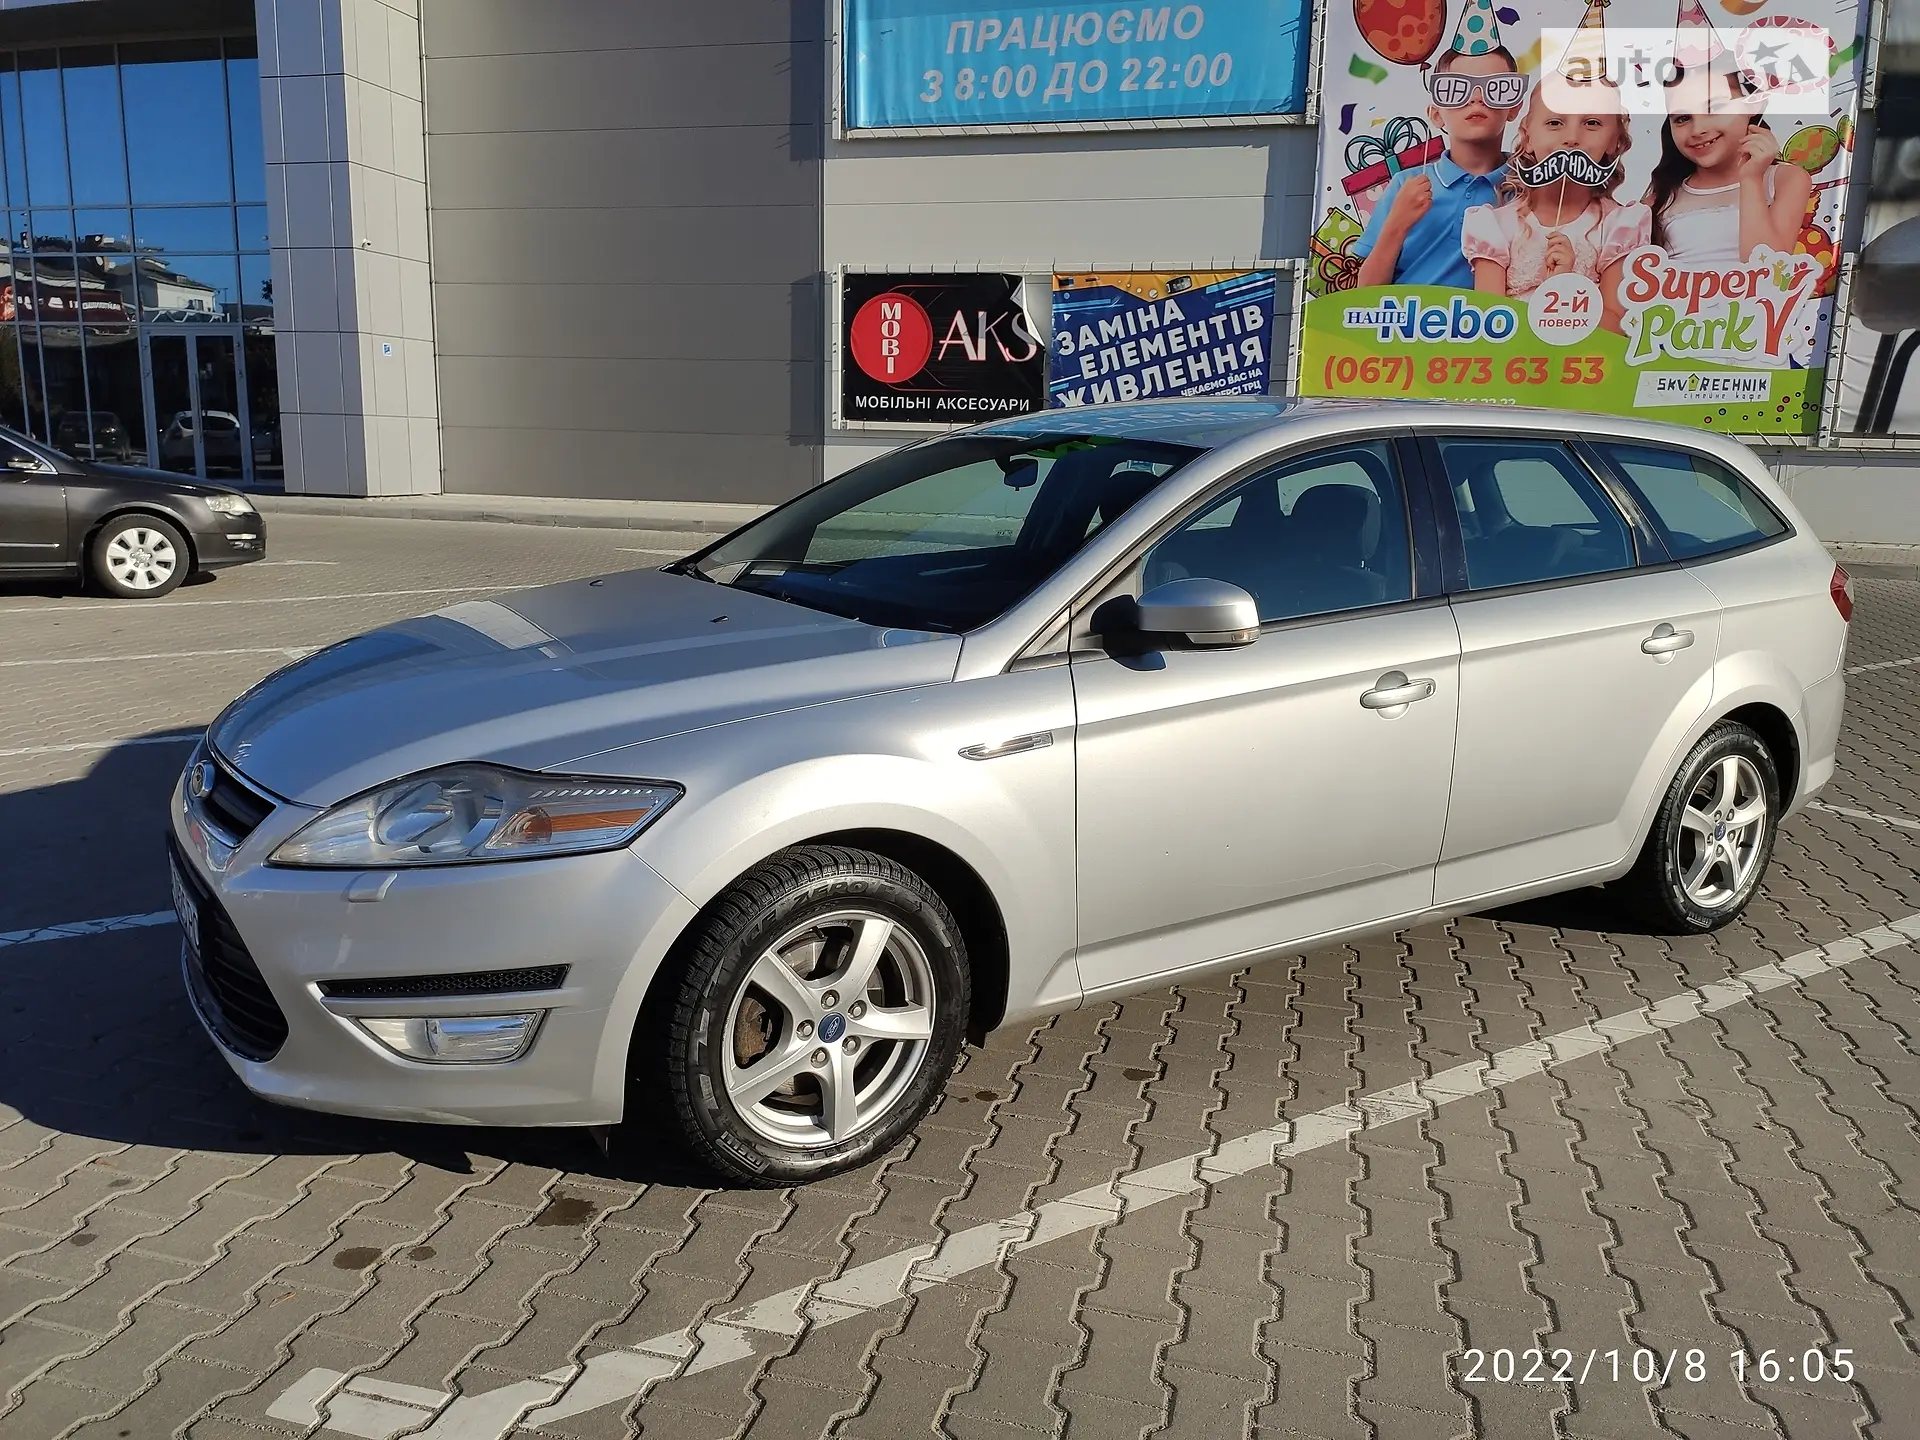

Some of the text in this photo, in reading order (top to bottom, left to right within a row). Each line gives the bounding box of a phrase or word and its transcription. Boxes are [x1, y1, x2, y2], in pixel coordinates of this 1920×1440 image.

[946, 4, 1204, 56] ПРАЦЮЄМО
[954, 64, 1037, 100] 8:00
[1043, 59, 1108, 104] ДО
[1120, 52, 1234, 92] 22:00
[1626, 253, 1770, 315] Super
[938, 309, 1037, 362] AKS
[1057, 297, 1185, 356] ЗАМІНА
[1080, 304, 1264, 381] ЕЛЕМЕНТІВ
[1347, 312, 1407, 324] НАШЕ
[1381, 299, 1515, 339] Nebo
[1538, 316, 1589, 330] поверх
[1634, 300, 1758, 359] Park
[1057, 339, 1265, 407] ЖИВЛЕННЯ
[1227, 372, 1247, 385] ВАС
[1248, 367, 1263, 379] НА
[1242, 380, 1261, 392] ТРЦ
[1324, 355, 1605, 391] (067) 873 63 53
[855, 395, 1031, 412] МОБІЛЬНІ АКСЕСУАРИ
